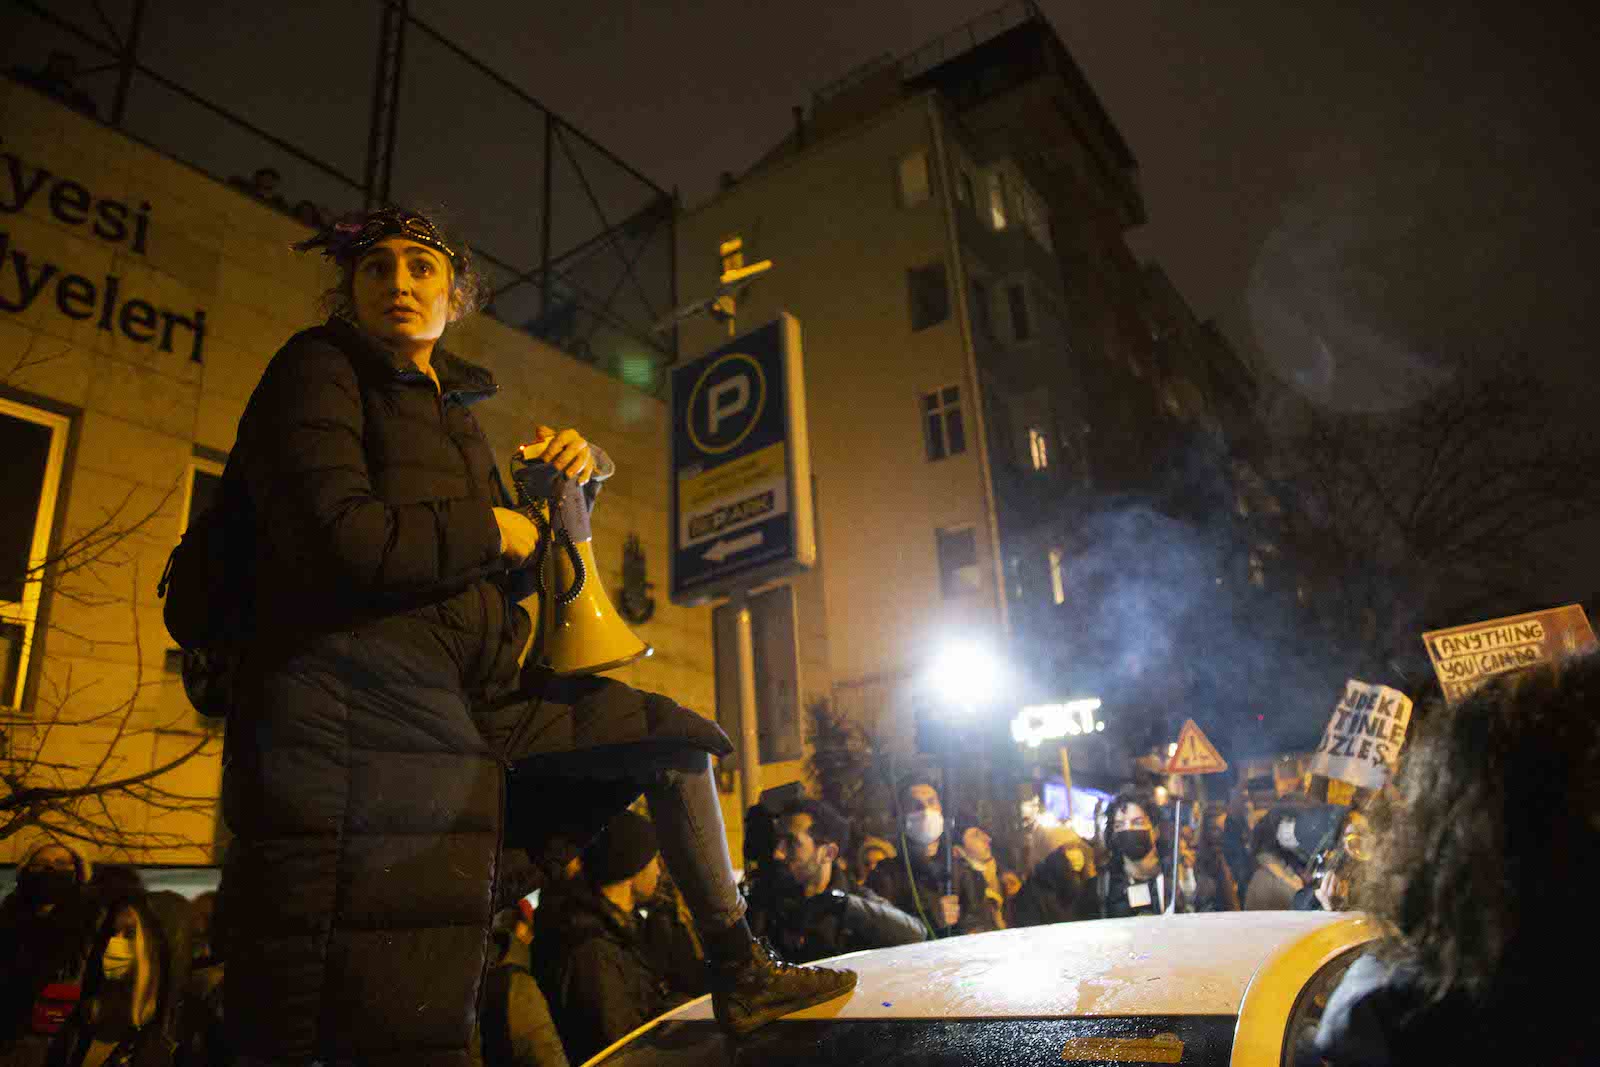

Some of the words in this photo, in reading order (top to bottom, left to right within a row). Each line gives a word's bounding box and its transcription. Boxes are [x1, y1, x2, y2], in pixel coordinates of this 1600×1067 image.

[708, 372, 751, 434] P
[1441, 623, 1543, 653] ANYTHING
[1442, 661, 1474, 680] YOU
